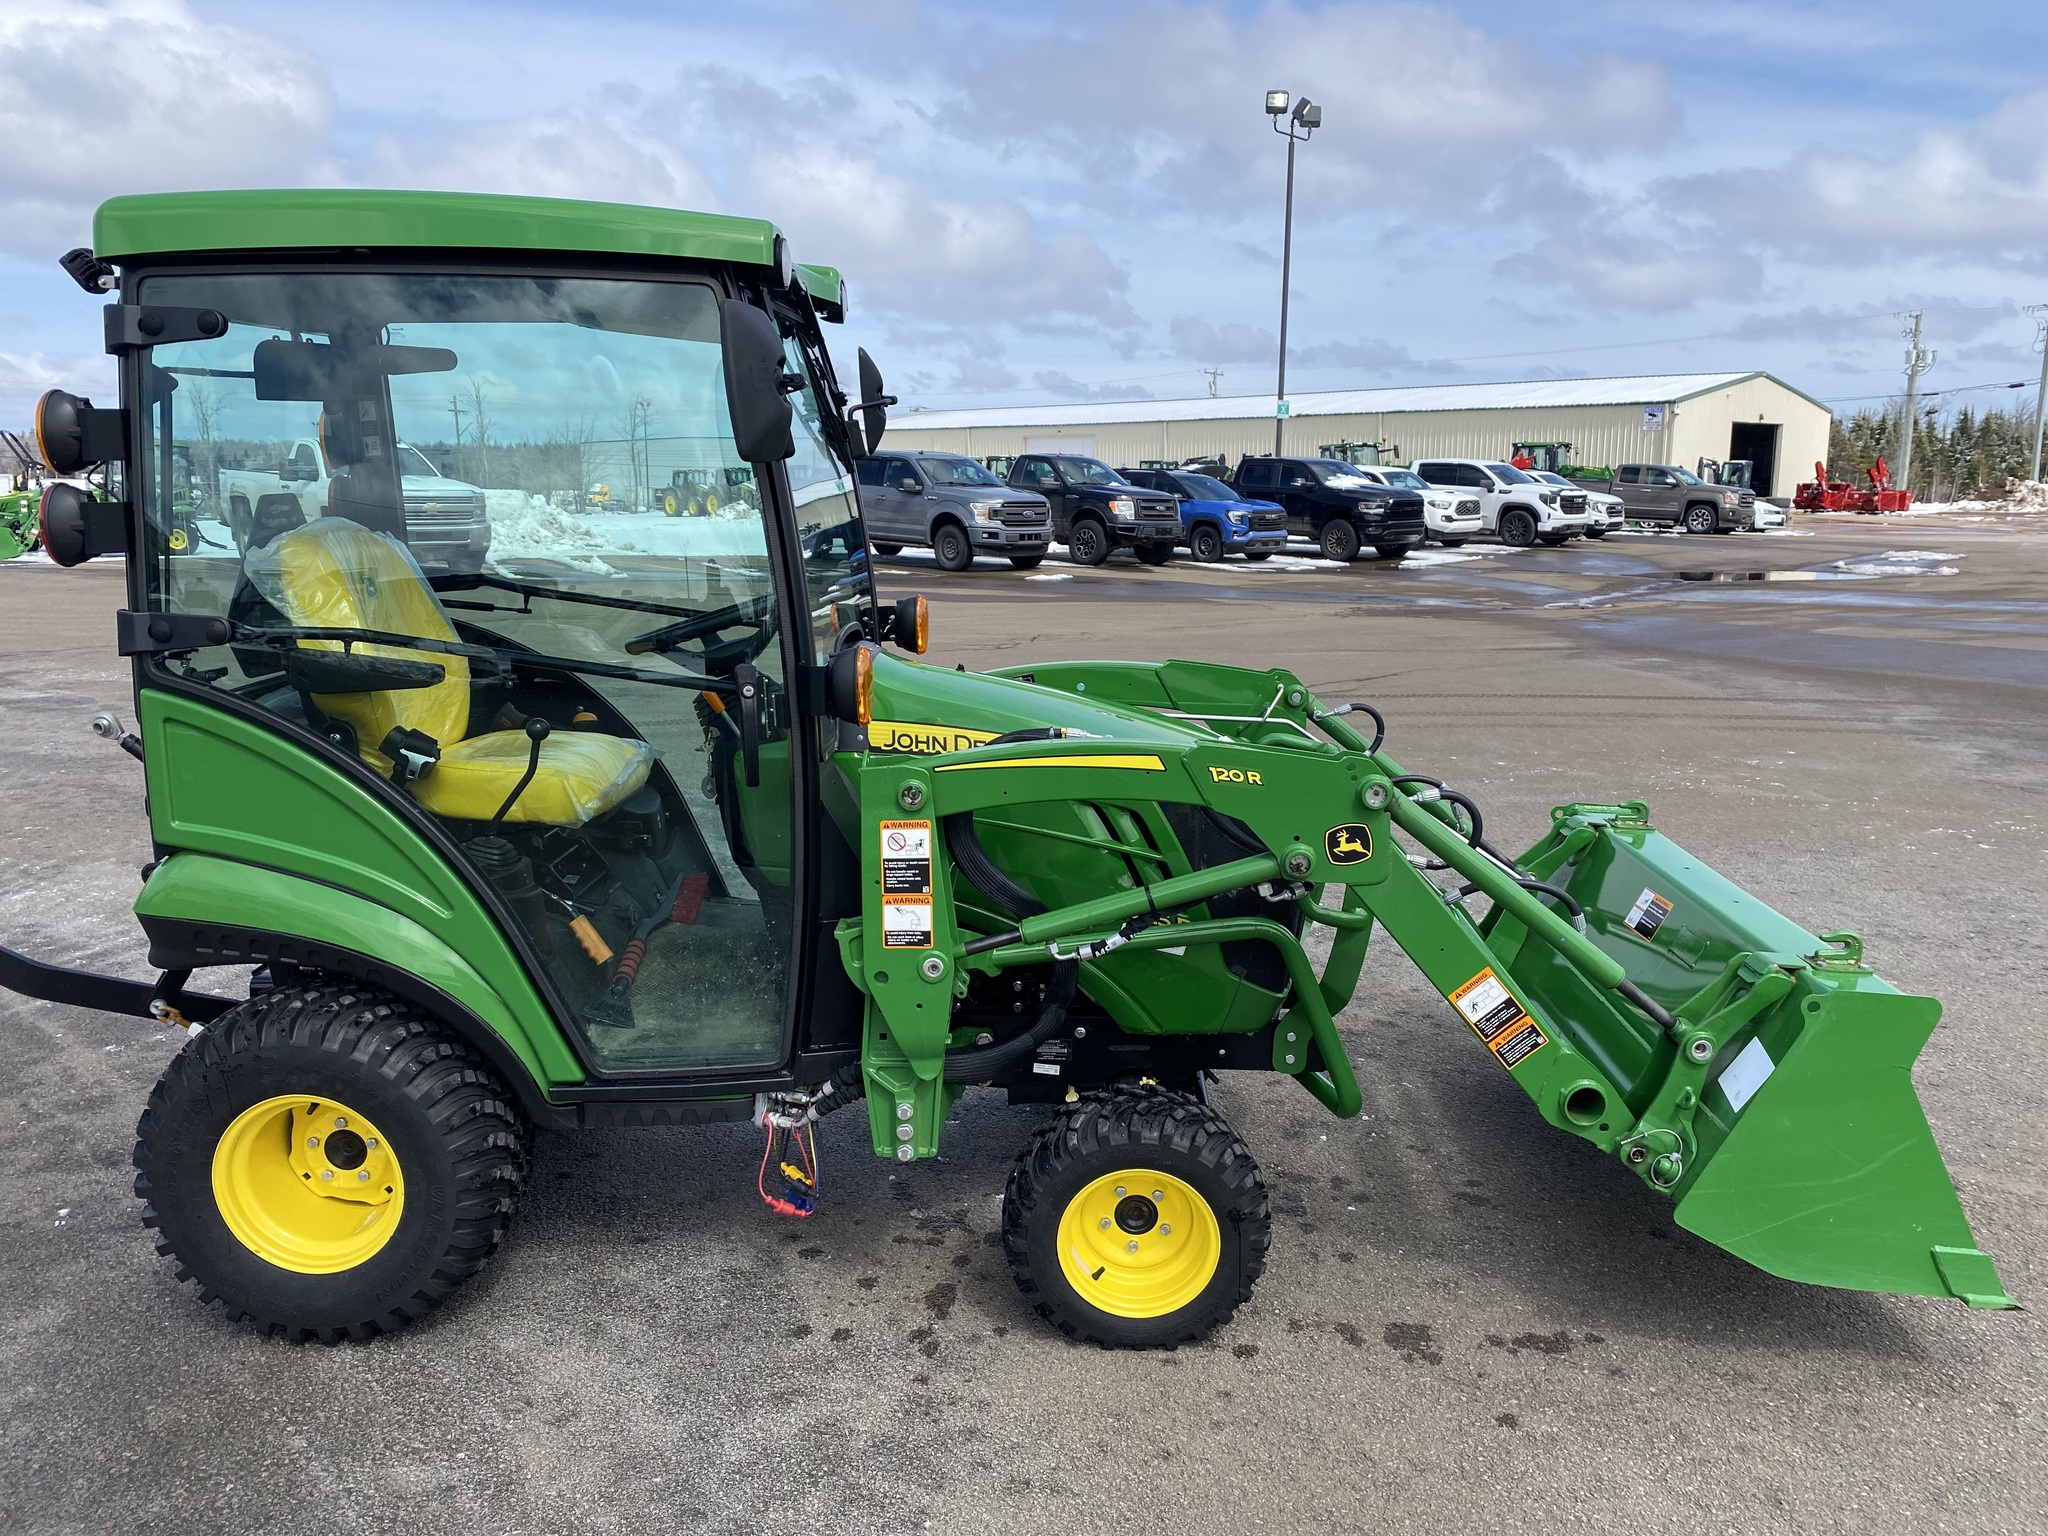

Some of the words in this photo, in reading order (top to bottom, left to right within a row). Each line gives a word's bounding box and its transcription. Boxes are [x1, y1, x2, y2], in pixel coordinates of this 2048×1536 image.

[883, 729, 947, 752] JOHN
[1207, 766, 1245, 784] 120
[1246, 770, 1264, 786] R
[890, 821, 928, 829] WARNING
[892, 897, 930, 905] WARNING
[1461, 972, 1488, 994] WARNING
[1501, 1021, 1529, 1041] WARNING
